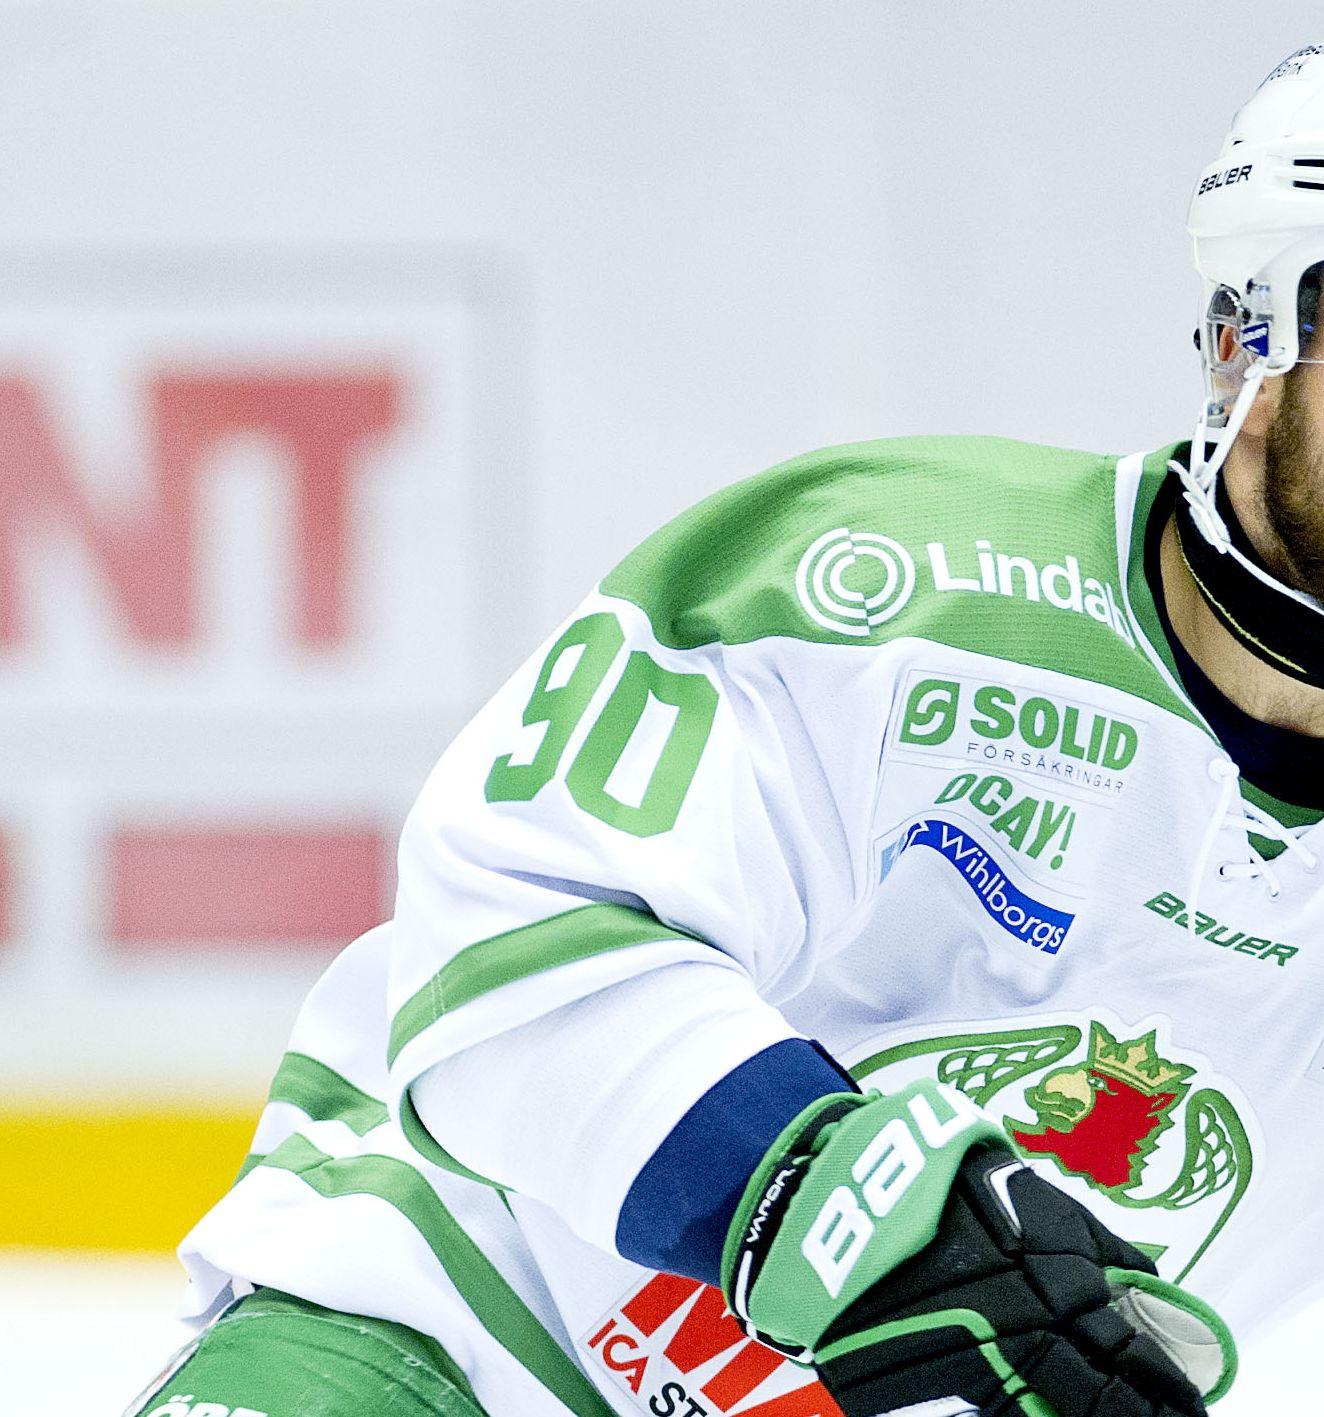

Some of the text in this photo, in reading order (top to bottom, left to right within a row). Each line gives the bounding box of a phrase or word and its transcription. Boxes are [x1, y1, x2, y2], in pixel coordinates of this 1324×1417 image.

[926, 539, 1136, 650] Lindab
[484, 612, 720, 838] 90
[970, 685, 1139, 771] SOLID
[941, 825, 1066, 952] Wihlborgs
